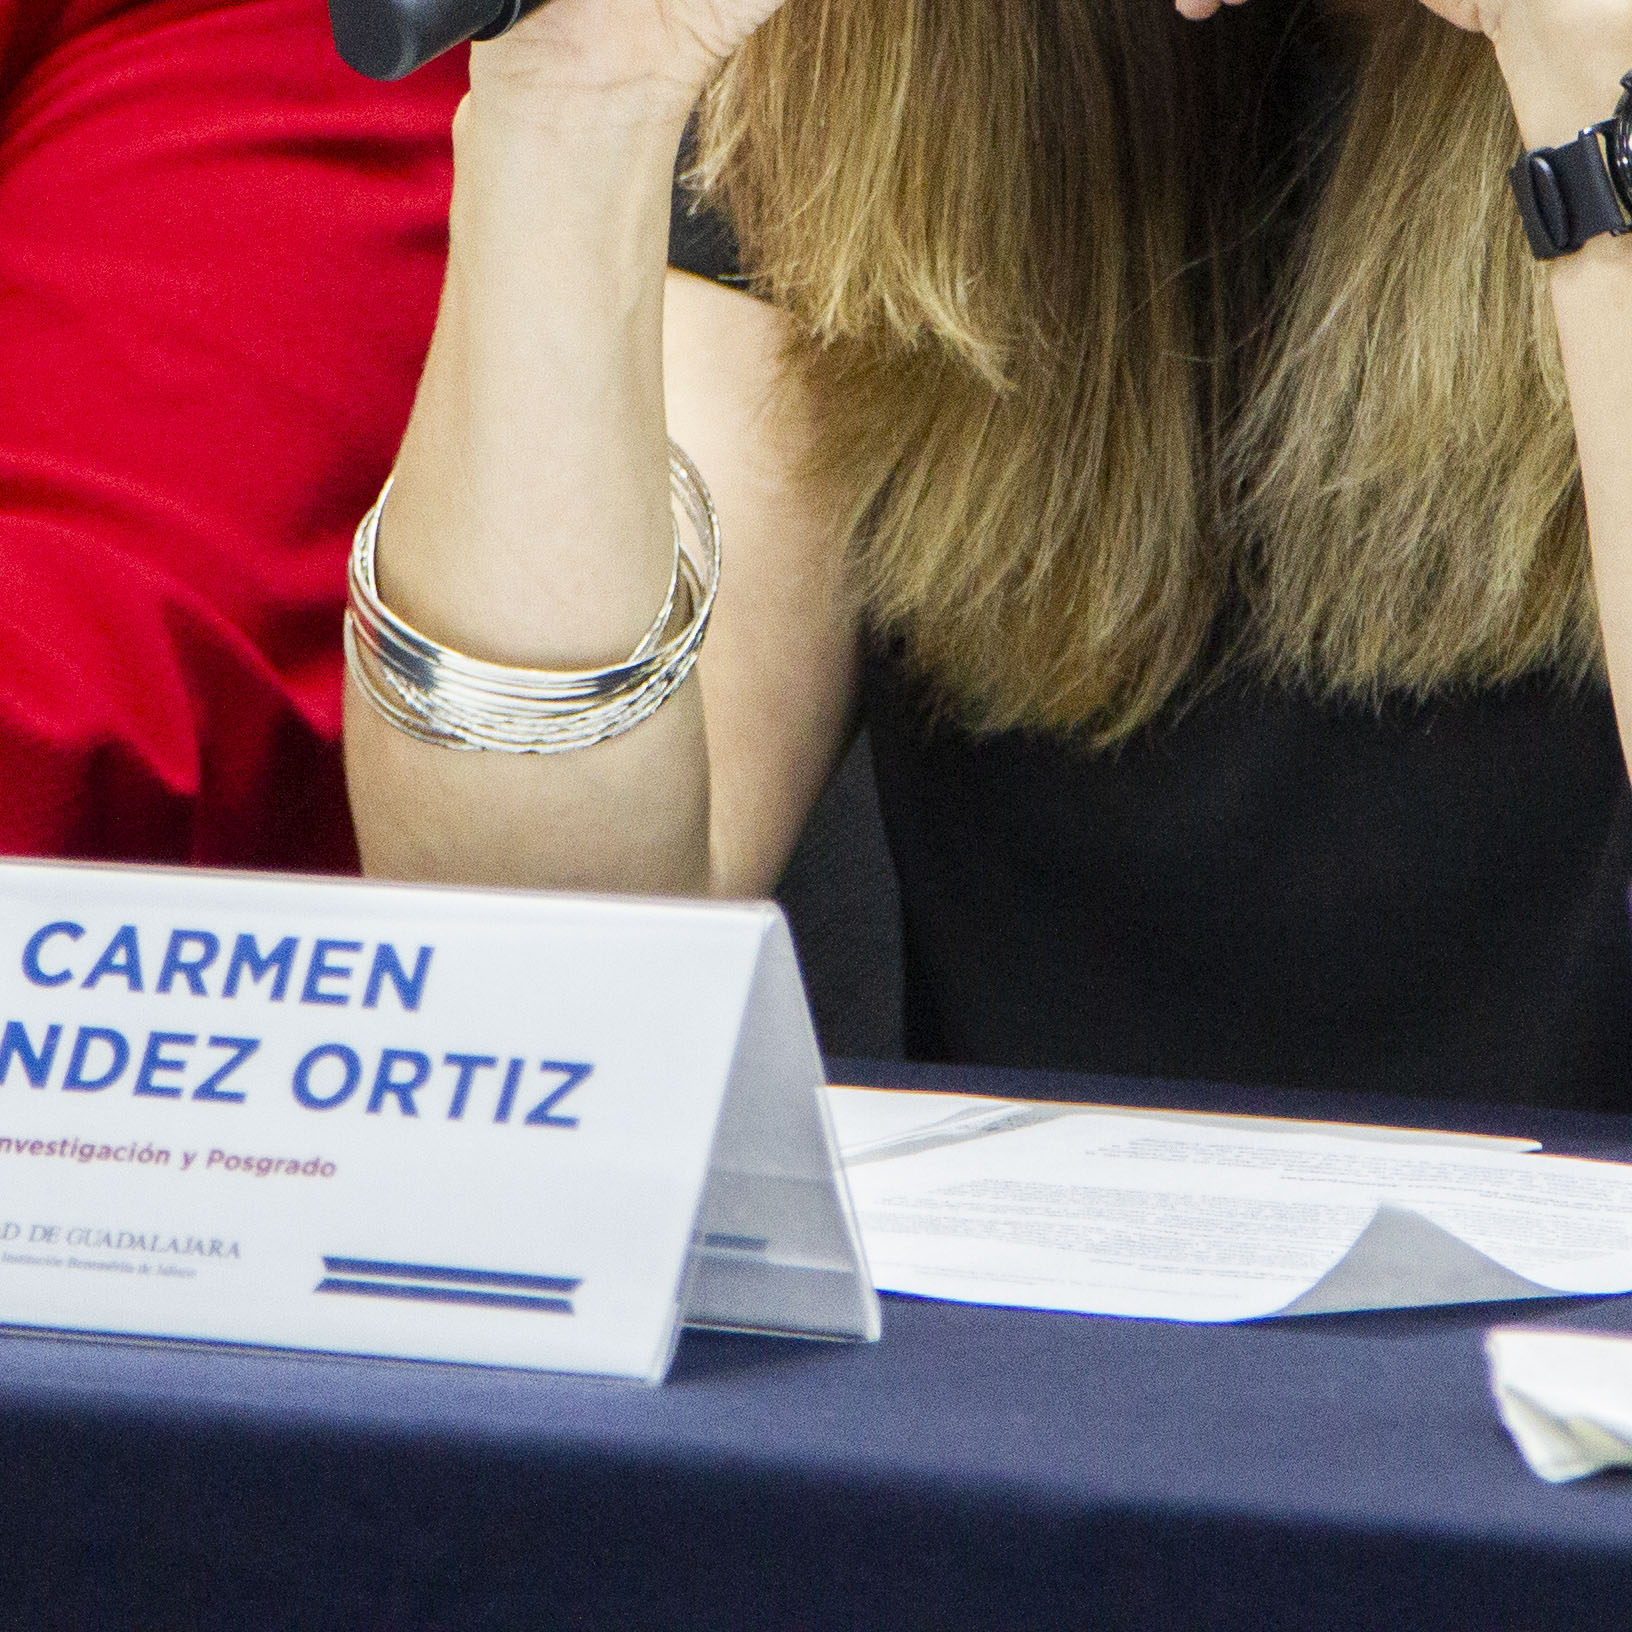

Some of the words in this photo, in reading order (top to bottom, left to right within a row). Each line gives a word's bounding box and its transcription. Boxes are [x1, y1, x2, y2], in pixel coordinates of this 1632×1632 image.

[21, 920, 436, 1012] CARMEN
[291, 1042, 595, 1129] ORTIZ
[180, 1149, 197, 1171] y
[206, 1148, 338, 1178] Posgrado
[27, 1223, 61, 1244] DE
[66, 1226, 242, 1260] GUADALAJARA
